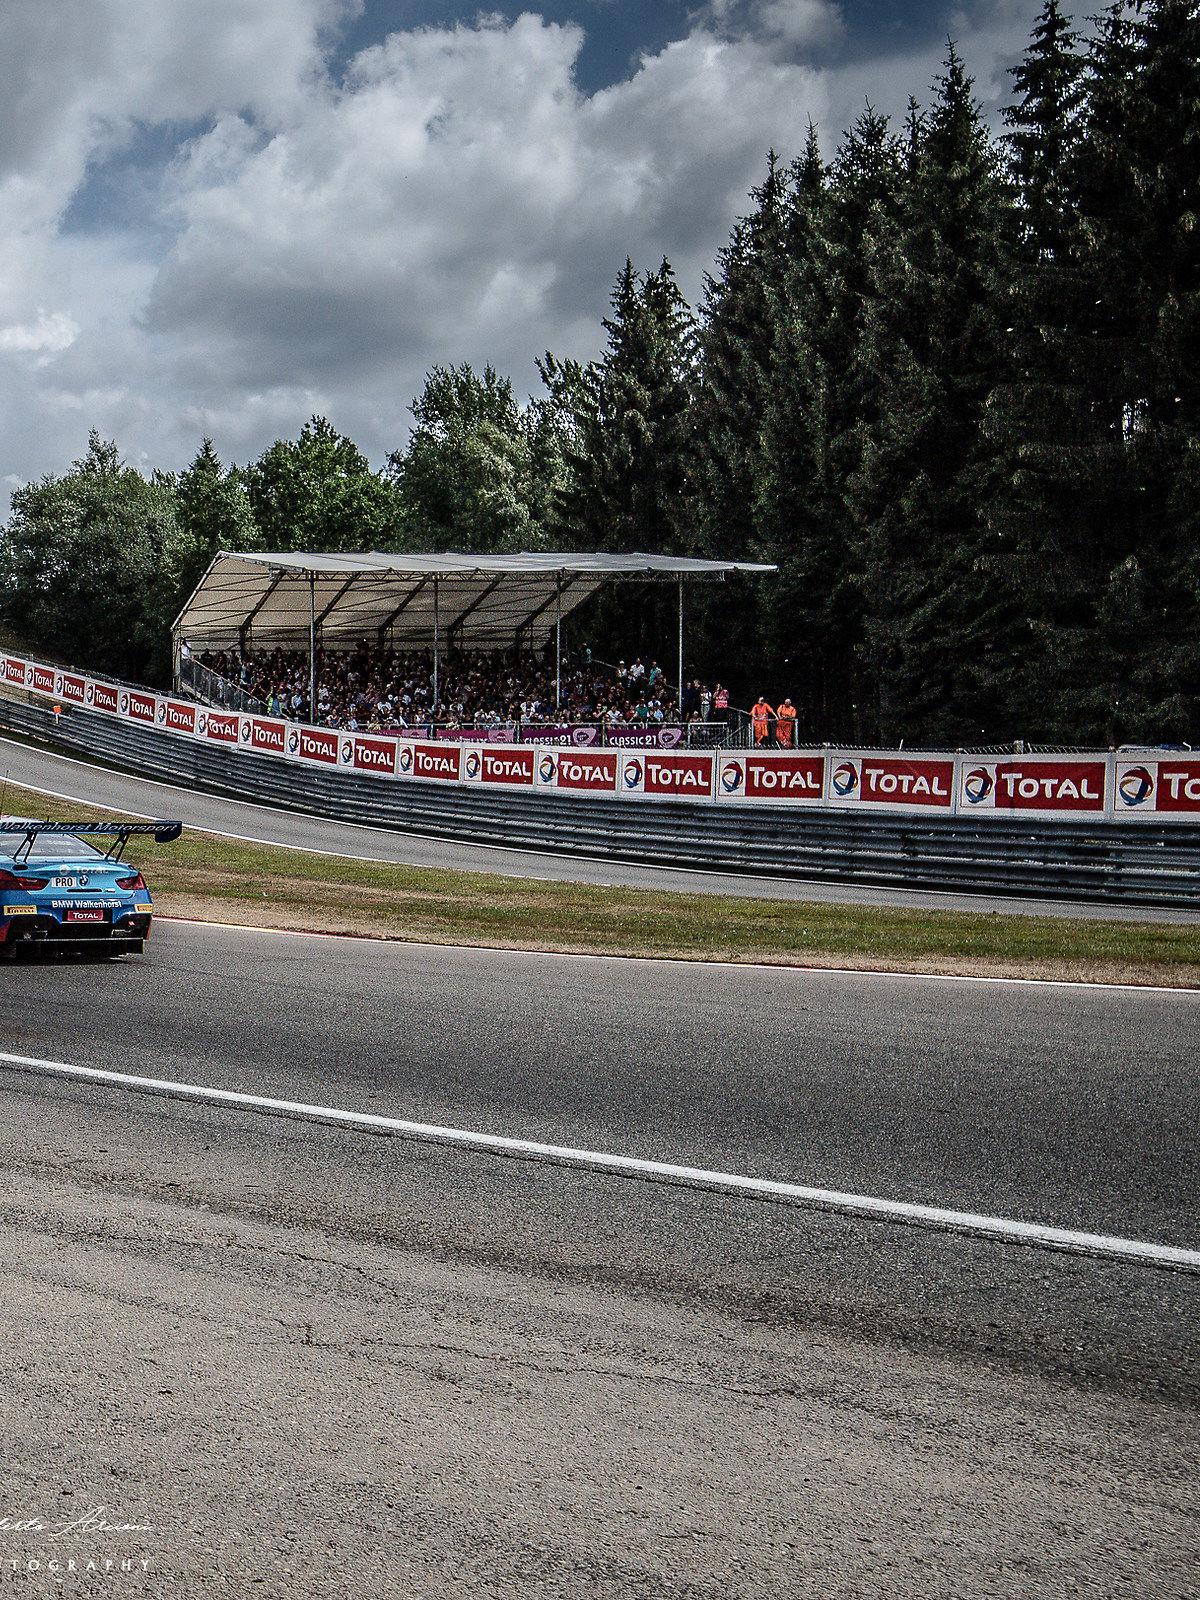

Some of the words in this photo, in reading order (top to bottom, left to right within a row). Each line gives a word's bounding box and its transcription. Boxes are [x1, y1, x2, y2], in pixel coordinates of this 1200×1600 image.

[7, 663, 25, 680] TOTAL
[35, 672, 53, 688] TOTAL
[64, 681, 84, 698] TOTAL
[95, 689, 116, 707] TOTAL
[130, 698, 154, 717] TOTAL
[168, 708, 193, 727] TOTAL
[208, 718, 238, 737] TOTAL
[253, 725, 284, 746] TOTAL
[301, 736, 337, 758] TOTAL
[356, 745, 394, 767] TOTAL
[415, 752, 458, 773] TOTAL
[484, 756, 531, 777] TOTAL
[560, 761, 614, 782] TOTAL
[647, 764, 709, 788] TOTAL
[749, 766, 821, 789] TOTAL
[865, 768, 947, 796] TOTAL
[1001, 772, 1099, 799] TOTAL
[0, 822, 92, 832] Walkenhorst
[94, 822, 178, 833] Motorsport
[55, 878, 73, 887] PRO
[52, 900, 73, 908] BMW
[75, 900, 122, 908] Walkenhorst
